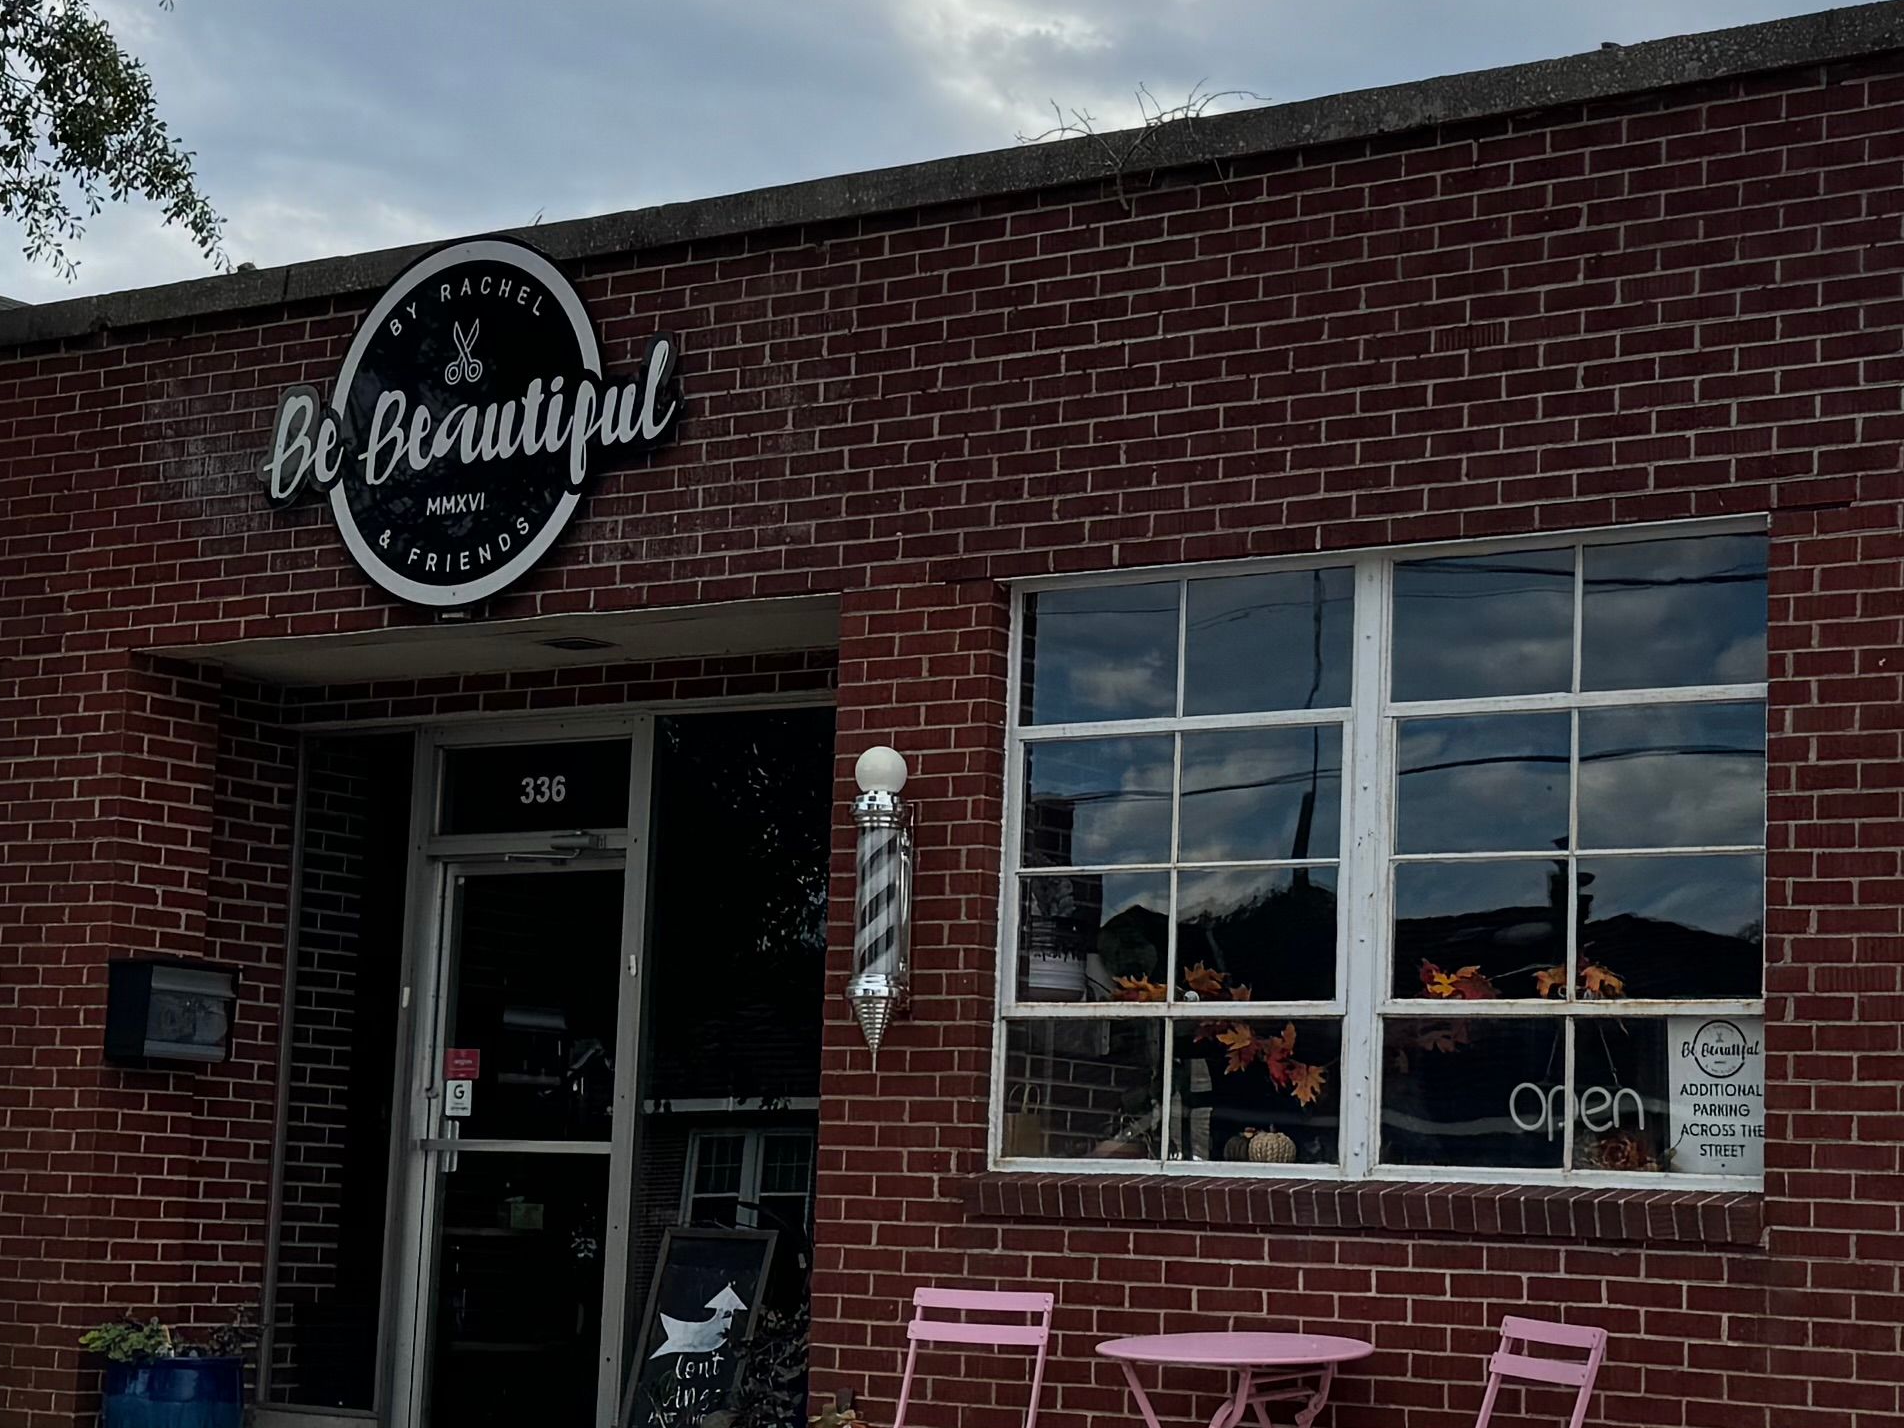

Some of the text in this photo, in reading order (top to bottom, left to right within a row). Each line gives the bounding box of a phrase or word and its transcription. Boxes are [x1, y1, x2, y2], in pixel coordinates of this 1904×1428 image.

[389, 275, 543, 336] BY RACHEL
[263, 339, 676, 500] Be Beautiful
[426, 491, 485, 516] MMXVI
[378, 516, 530, 573] & FRIENDS
[520, 775, 566, 804] 336
[1680, 1083, 1763, 1097] ADDITIONAL
[1509, 1082, 1645, 1142] open
[1693, 1103, 1751, 1117] PARKING
[1681, 1123, 1765, 1138] ACROSS THE
[1699, 1143, 1746, 1158] STREET
